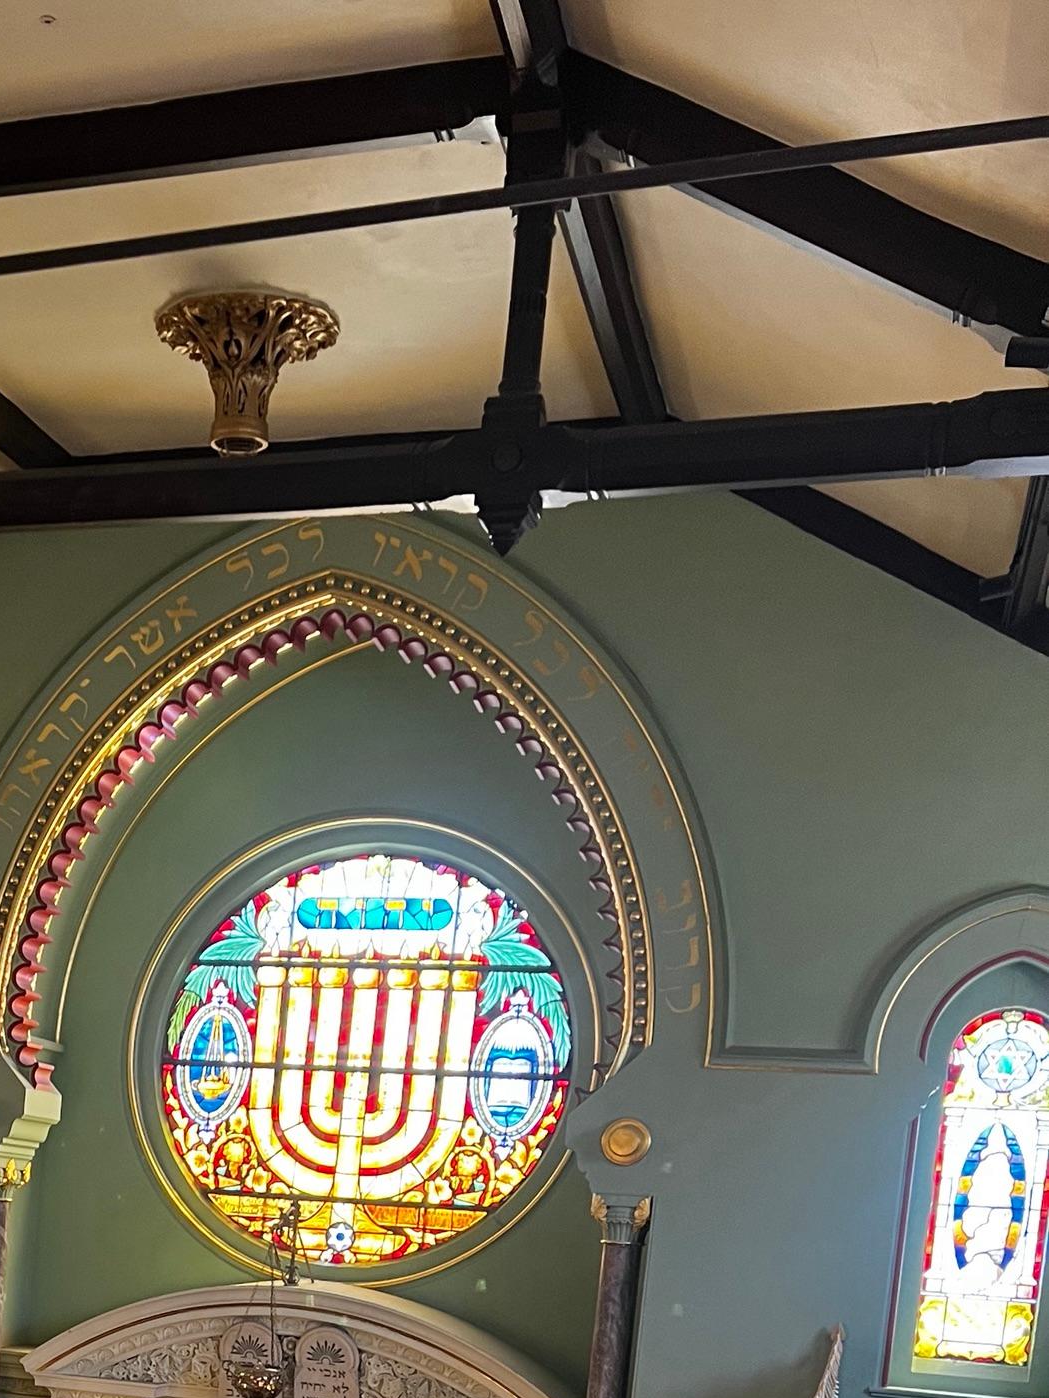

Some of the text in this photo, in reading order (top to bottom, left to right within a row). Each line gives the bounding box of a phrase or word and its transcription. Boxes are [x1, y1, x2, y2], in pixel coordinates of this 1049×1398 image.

[225, 521, 325, 592] לכל
[373, 530, 488, 611] קראיו
[103, 595, 198, 670] אשר
[319, 1367, 347, 1379] אנכי
[332, 1381, 350, 1394] לא
